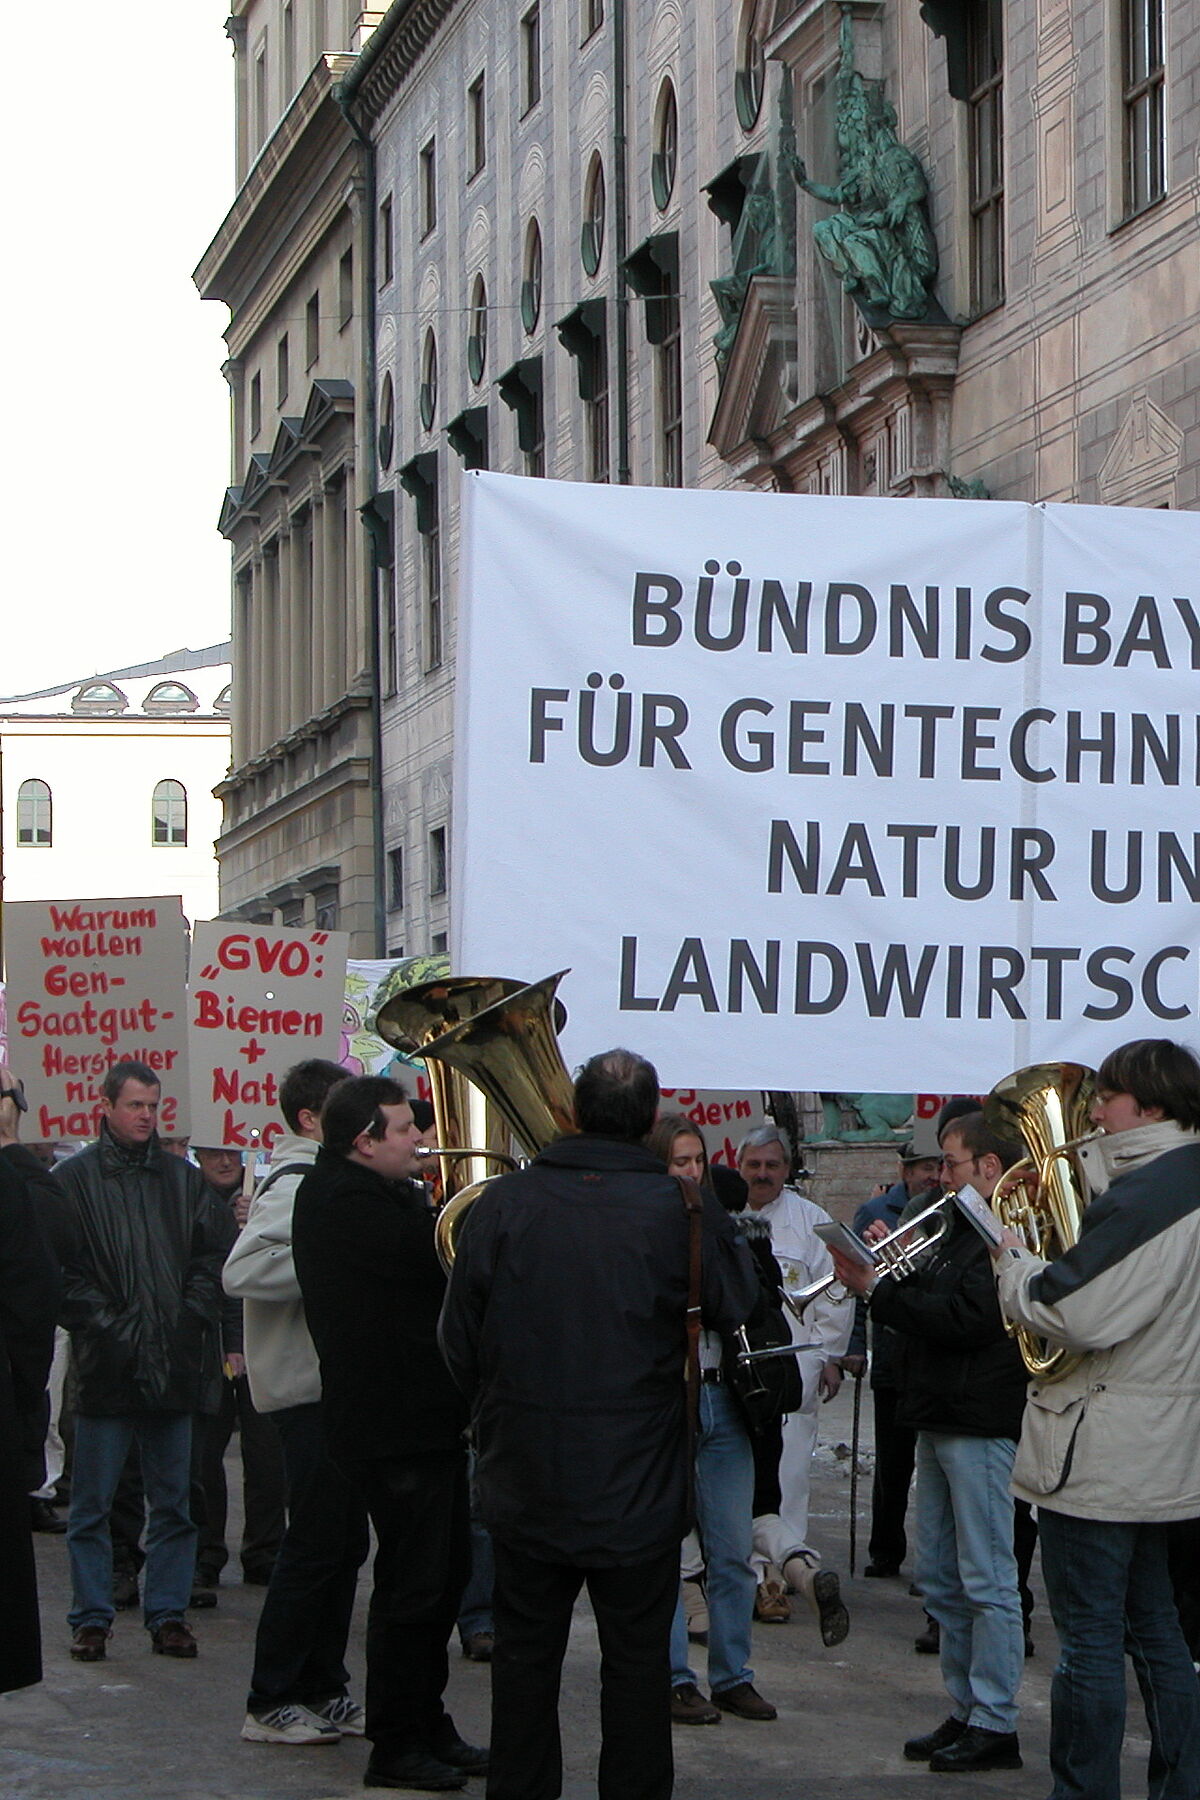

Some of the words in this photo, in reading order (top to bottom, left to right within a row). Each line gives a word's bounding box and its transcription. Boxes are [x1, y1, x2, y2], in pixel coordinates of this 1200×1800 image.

[632, 560, 1032, 664] BÜNDNIS
[529, 671, 693, 770] FÜR
[767, 819, 1058, 902] NATUR
[49, 905, 157, 932] Warum
[40, 932, 143, 958] wollen
[44, 964, 126, 997] Gen-
[16, 999, 175, 1047] Saatgut-
[193, 990, 323, 1037] Bienen
[212, 1067, 278, 1107] Nat
